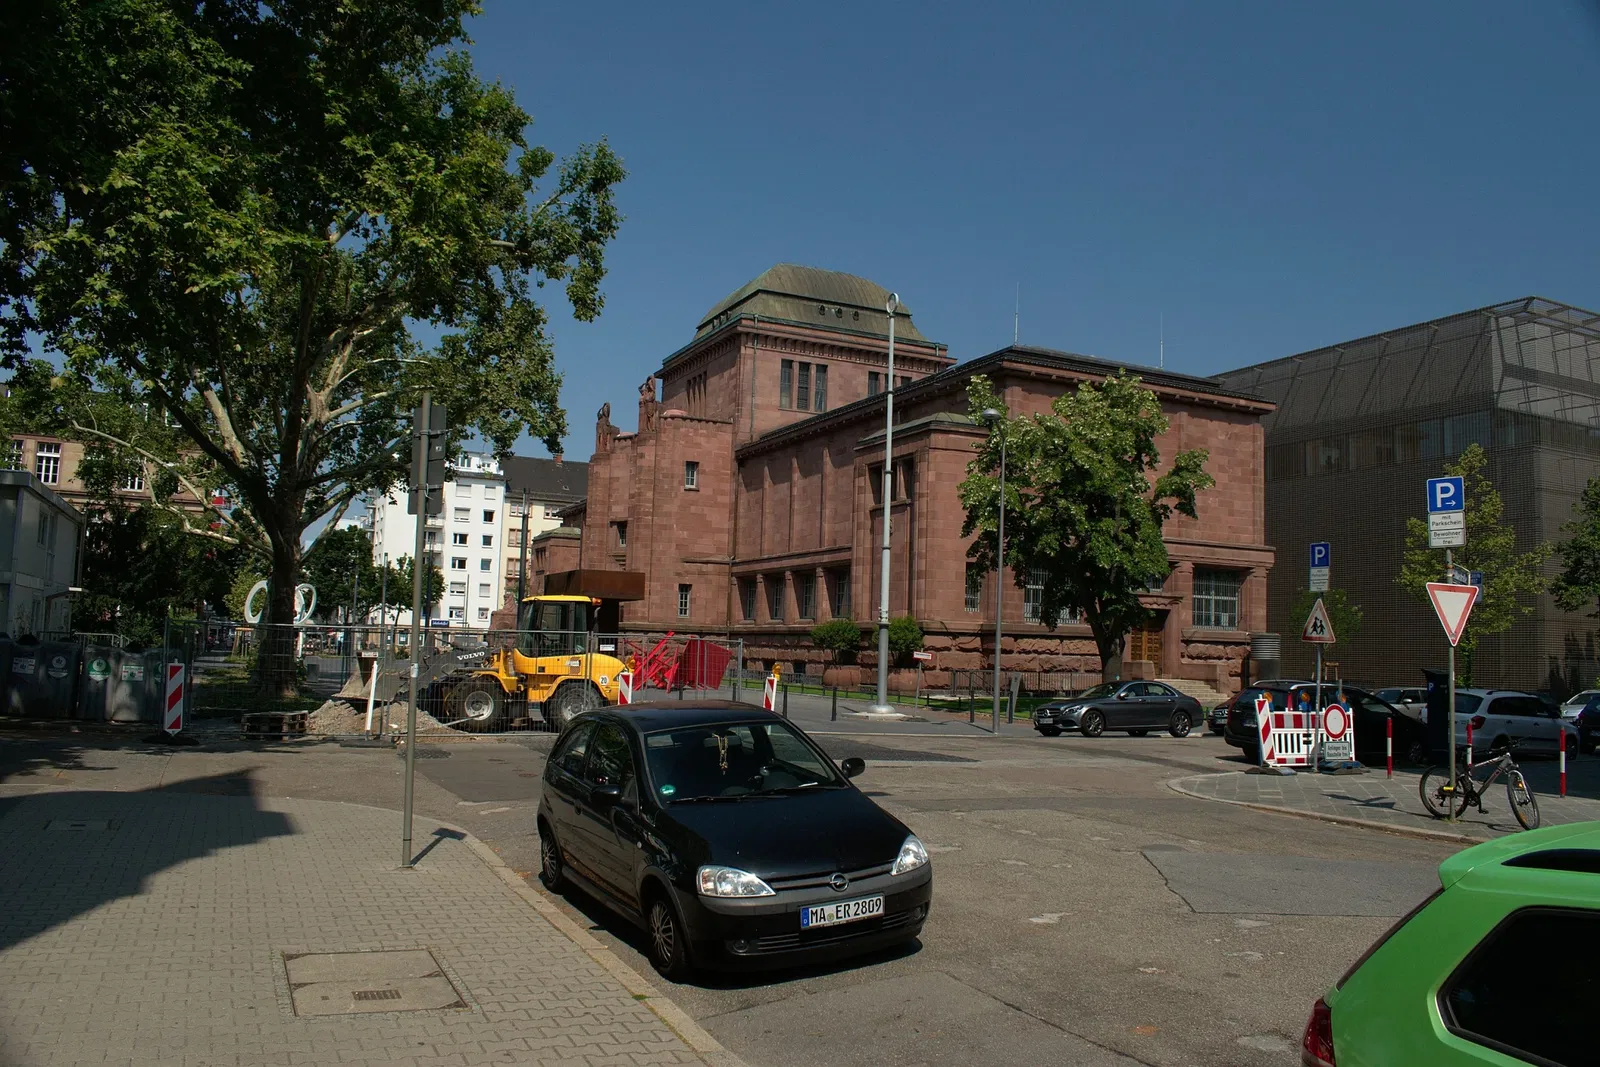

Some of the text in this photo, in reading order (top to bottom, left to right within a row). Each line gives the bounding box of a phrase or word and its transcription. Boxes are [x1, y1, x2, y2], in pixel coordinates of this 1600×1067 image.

[1436, 482, 1455, 508] P
[1315, 546, 1325, 565] P
[457, 651, 485, 661] VOLVO
[810, 908, 826, 924] MA
[835, 903, 851, 920] ER
[853, 898, 882, 917] 2809
